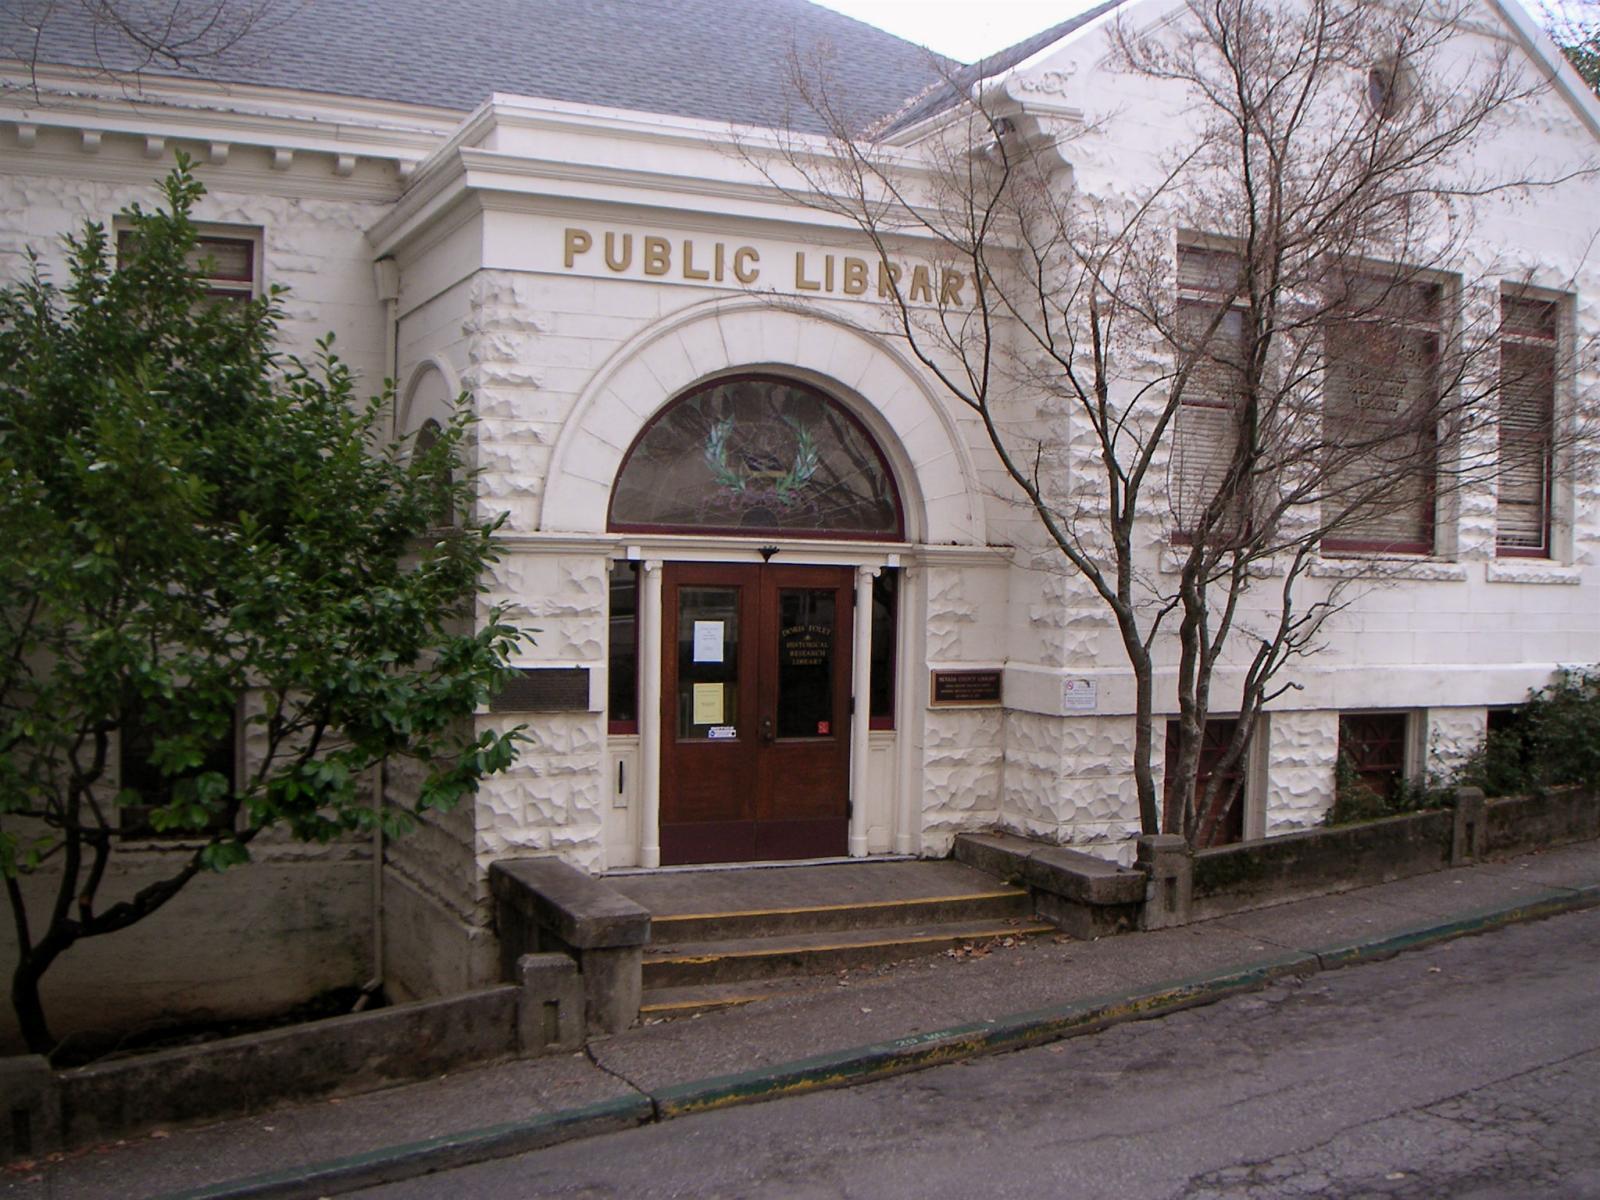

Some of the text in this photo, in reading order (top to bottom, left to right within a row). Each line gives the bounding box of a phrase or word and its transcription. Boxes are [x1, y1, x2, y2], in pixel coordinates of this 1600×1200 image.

[563, 227, 761, 284] PUBLIC
[789, 649, 826, 657] RESEARCH
[791, 657, 822, 665] LIBRARY
